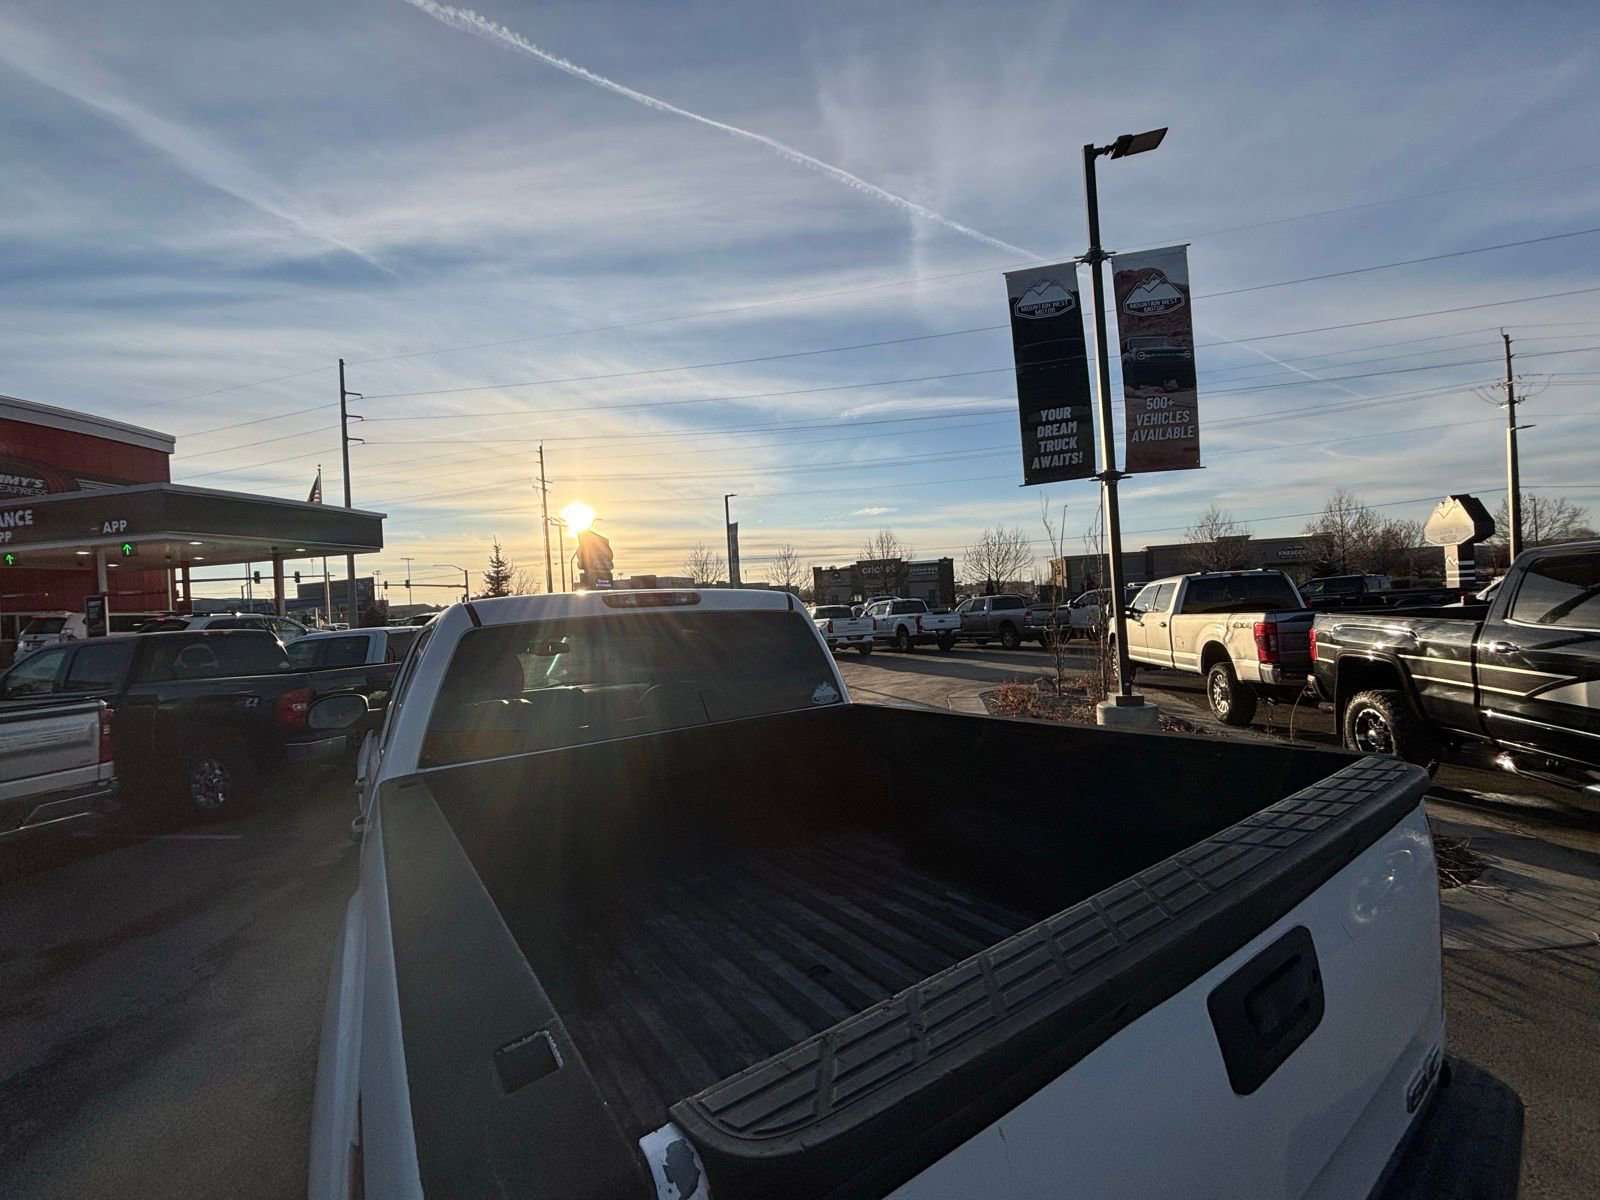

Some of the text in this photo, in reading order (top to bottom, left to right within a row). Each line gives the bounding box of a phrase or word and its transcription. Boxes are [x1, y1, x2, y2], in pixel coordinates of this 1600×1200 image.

[1020, 299, 1068, 311] MOUNTAIN WEST
[1129, 301, 1160, 309] MOUNTAIN
[1143, 305, 1165, 313] MOTOR
[1145, 396, 1175, 410] 500+
[1040, 406, 1072, 422] YOUR
[1136, 410, 1190, 426] VEHICLES
[1036, 421, 1078, 438] DREAM
[1131, 425, 1195, 443] AVAILABLE
[1038, 436, 1078, 453] TRUCK
[1031, 451, 1083, 470] AWAITS!
[102, 520, 128, 534] APP
